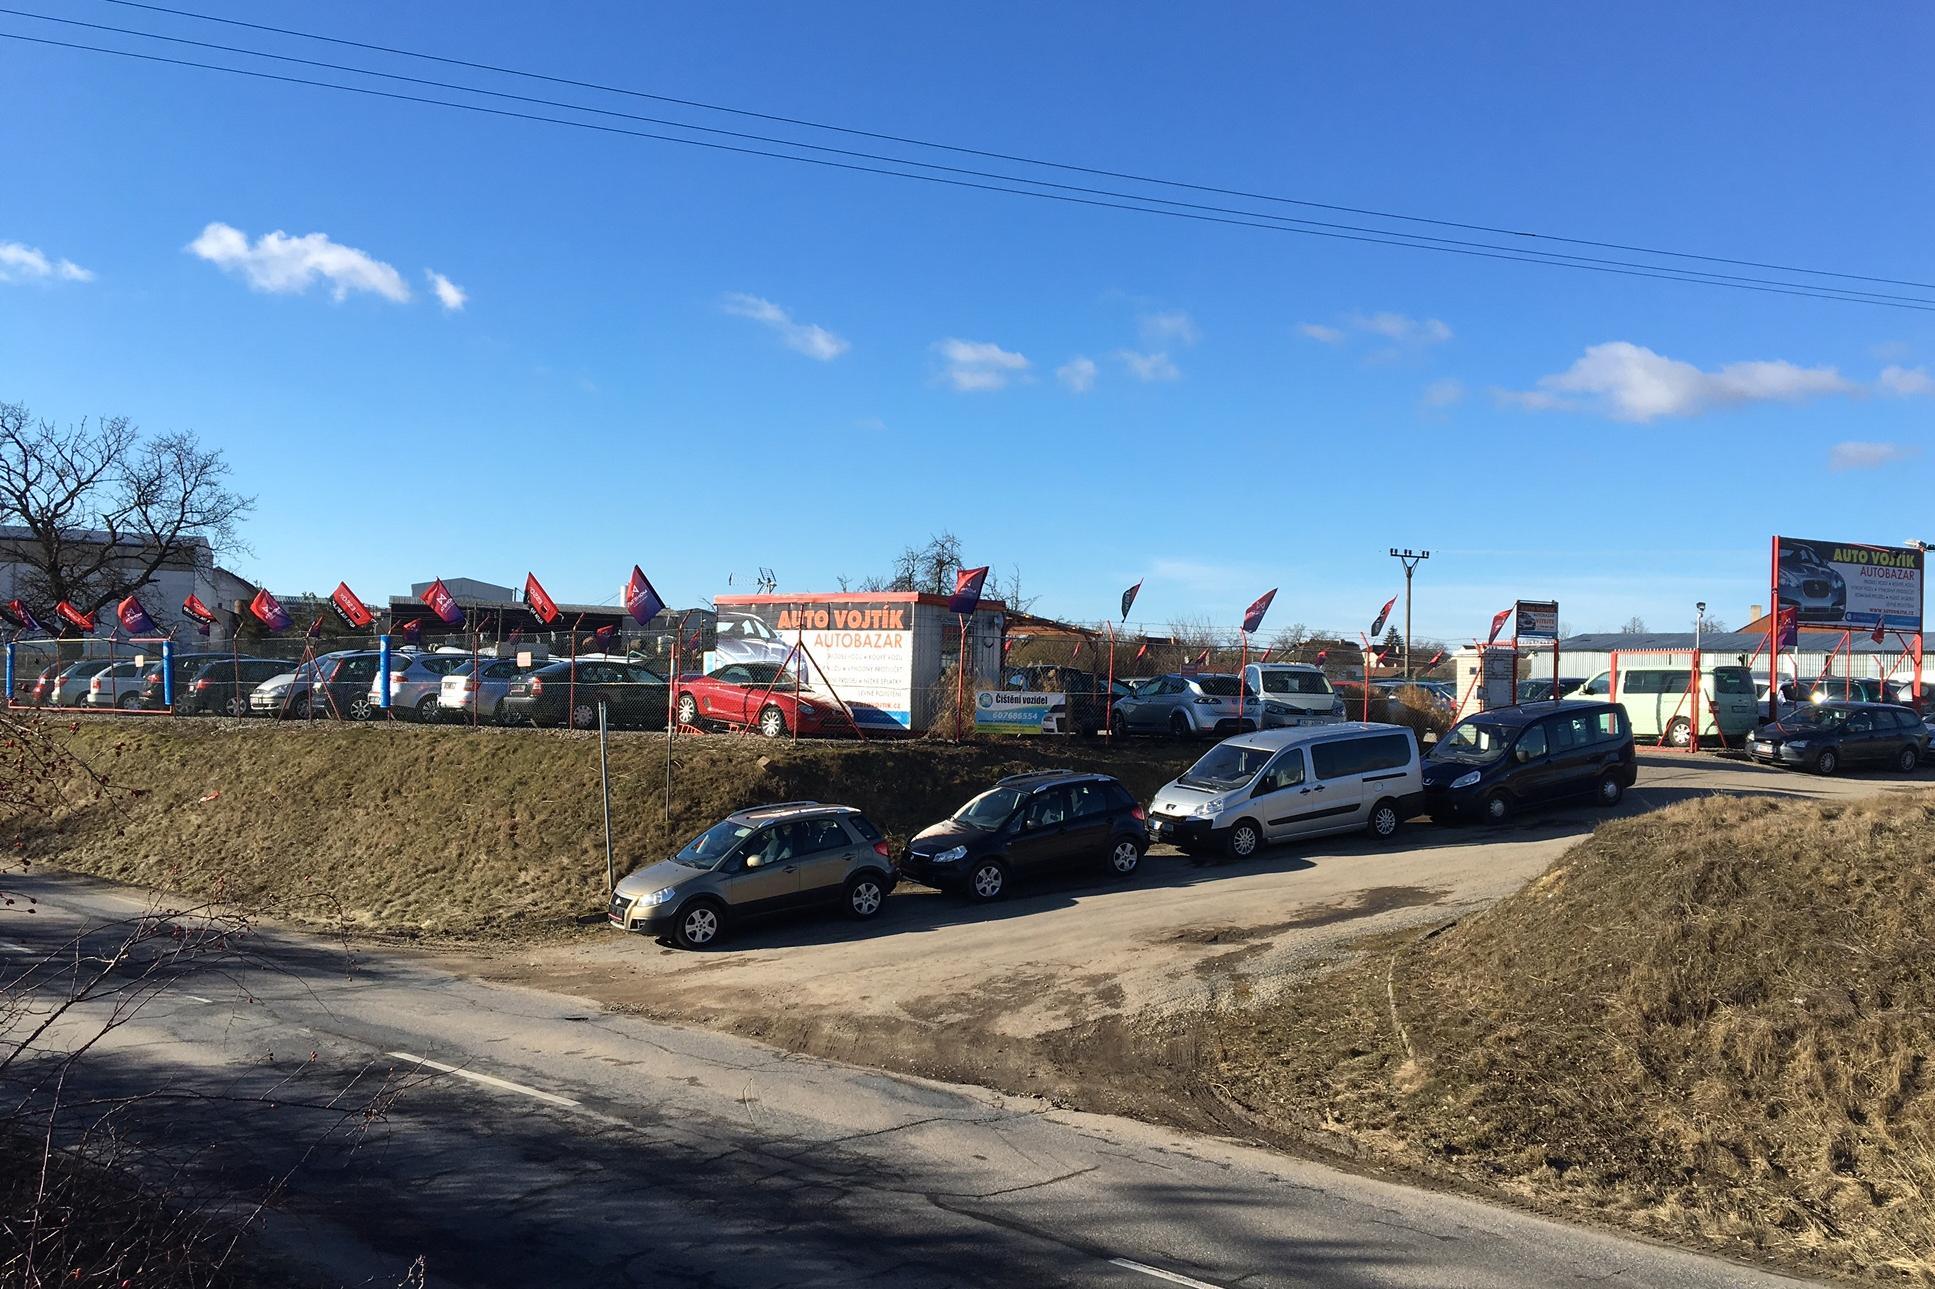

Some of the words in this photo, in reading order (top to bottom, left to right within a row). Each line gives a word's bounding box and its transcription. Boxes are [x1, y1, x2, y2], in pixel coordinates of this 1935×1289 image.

[1834, 548, 1868, 562] AUTO
[1861, 567, 1914, 580] AUTOBAZAR
[777, 609, 829, 629] AUTO
[833, 605, 904, 629] VOJTÍK
[814, 633, 903, 648] AUTOBAZAR
[995, 693, 1022, 704] Čištění
[1022, 694, 1048, 705] vozidel
